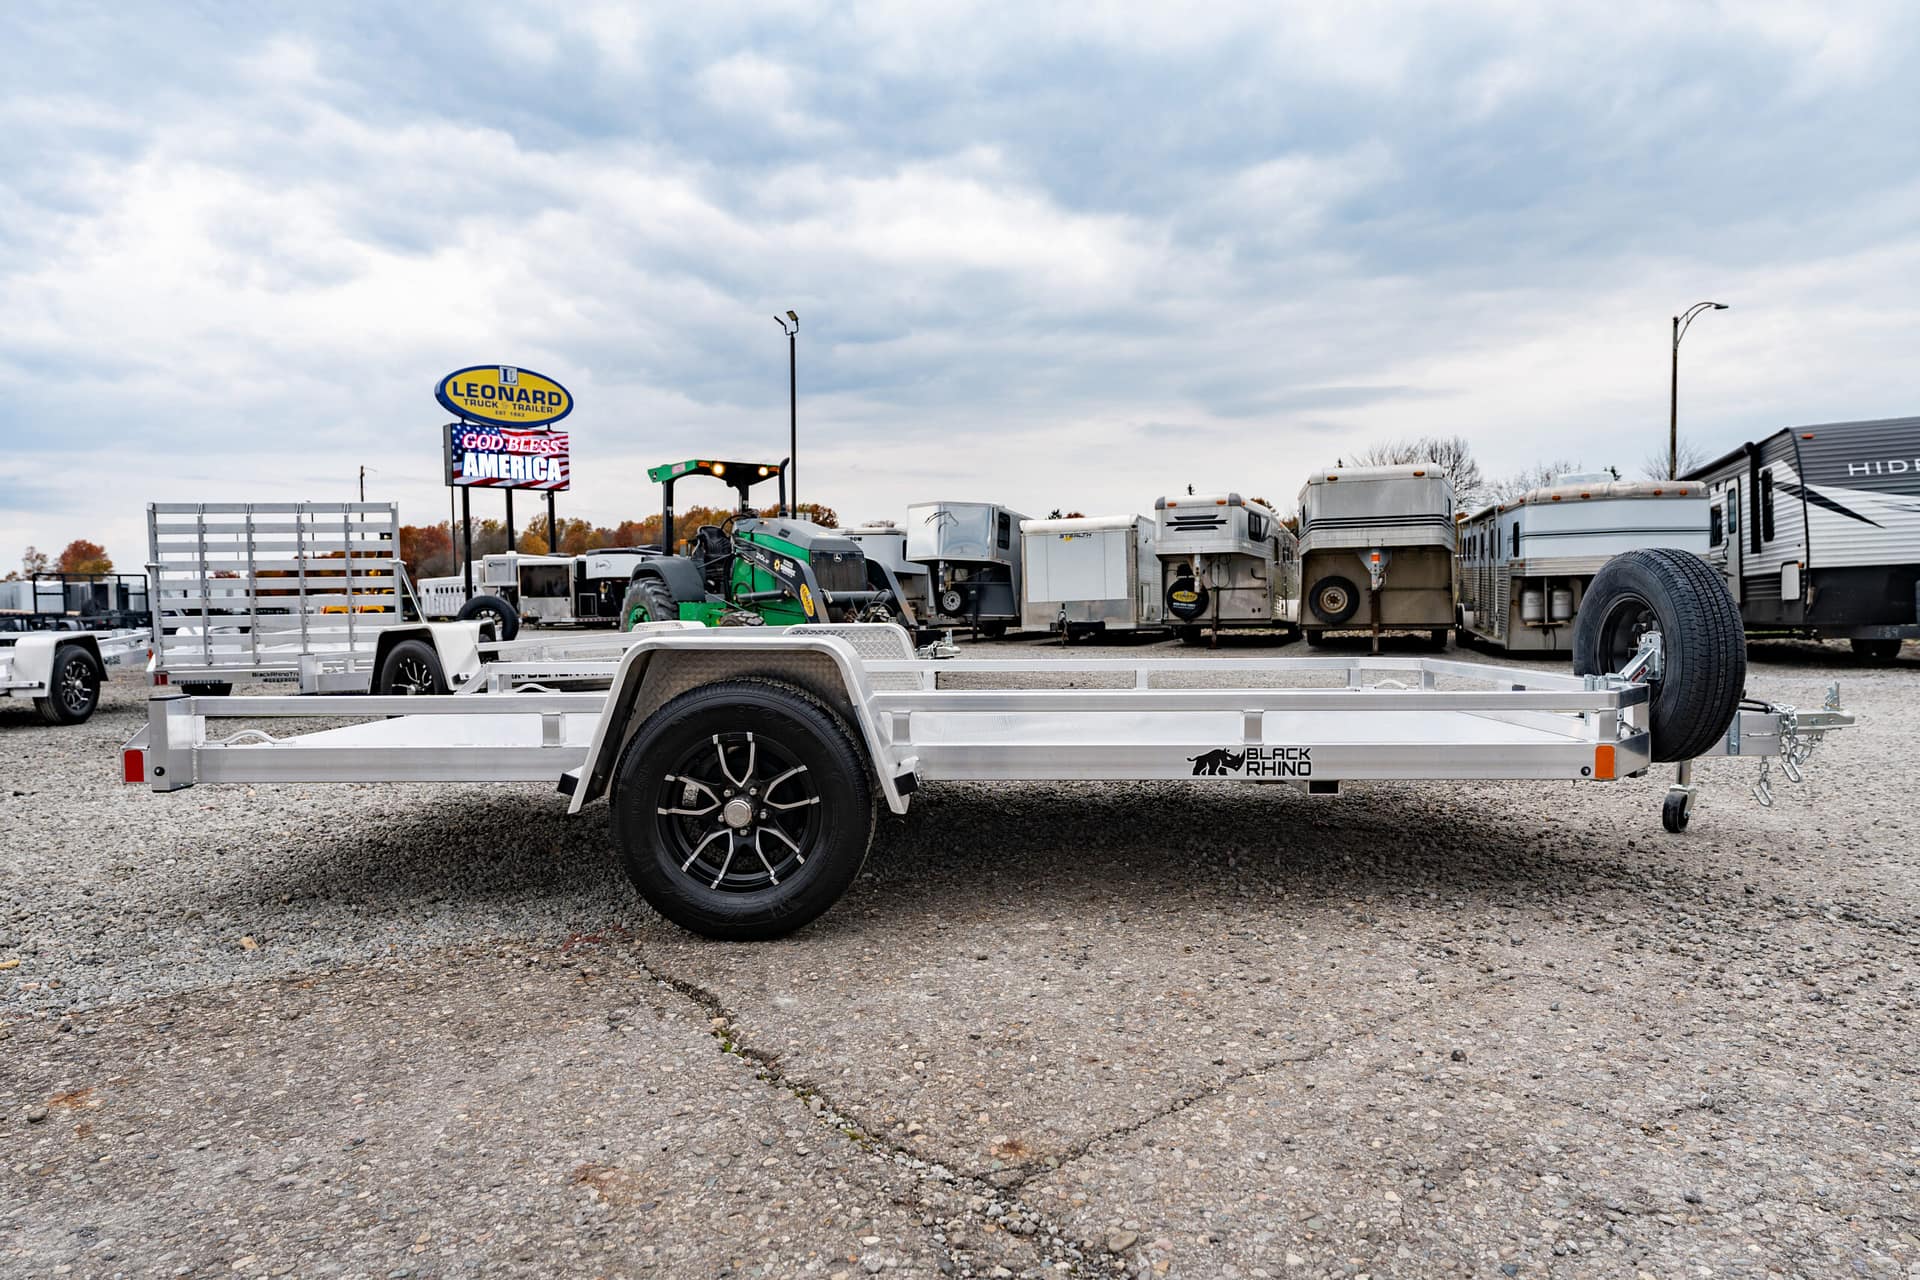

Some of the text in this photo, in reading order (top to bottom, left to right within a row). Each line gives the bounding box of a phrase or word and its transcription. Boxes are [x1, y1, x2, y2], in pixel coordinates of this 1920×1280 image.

[452, 381, 562, 406] LEONARD
[464, 398, 498, 409] TRUCK
[512, 403, 553, 414] TRAILER
[463, 433, 561, 455] GOD BLESS
[462, 452, 562, 482] AMERICA
[1246, 747, 1311, 760] BLACK
[1246, 761, 1312, 776] RHINO
